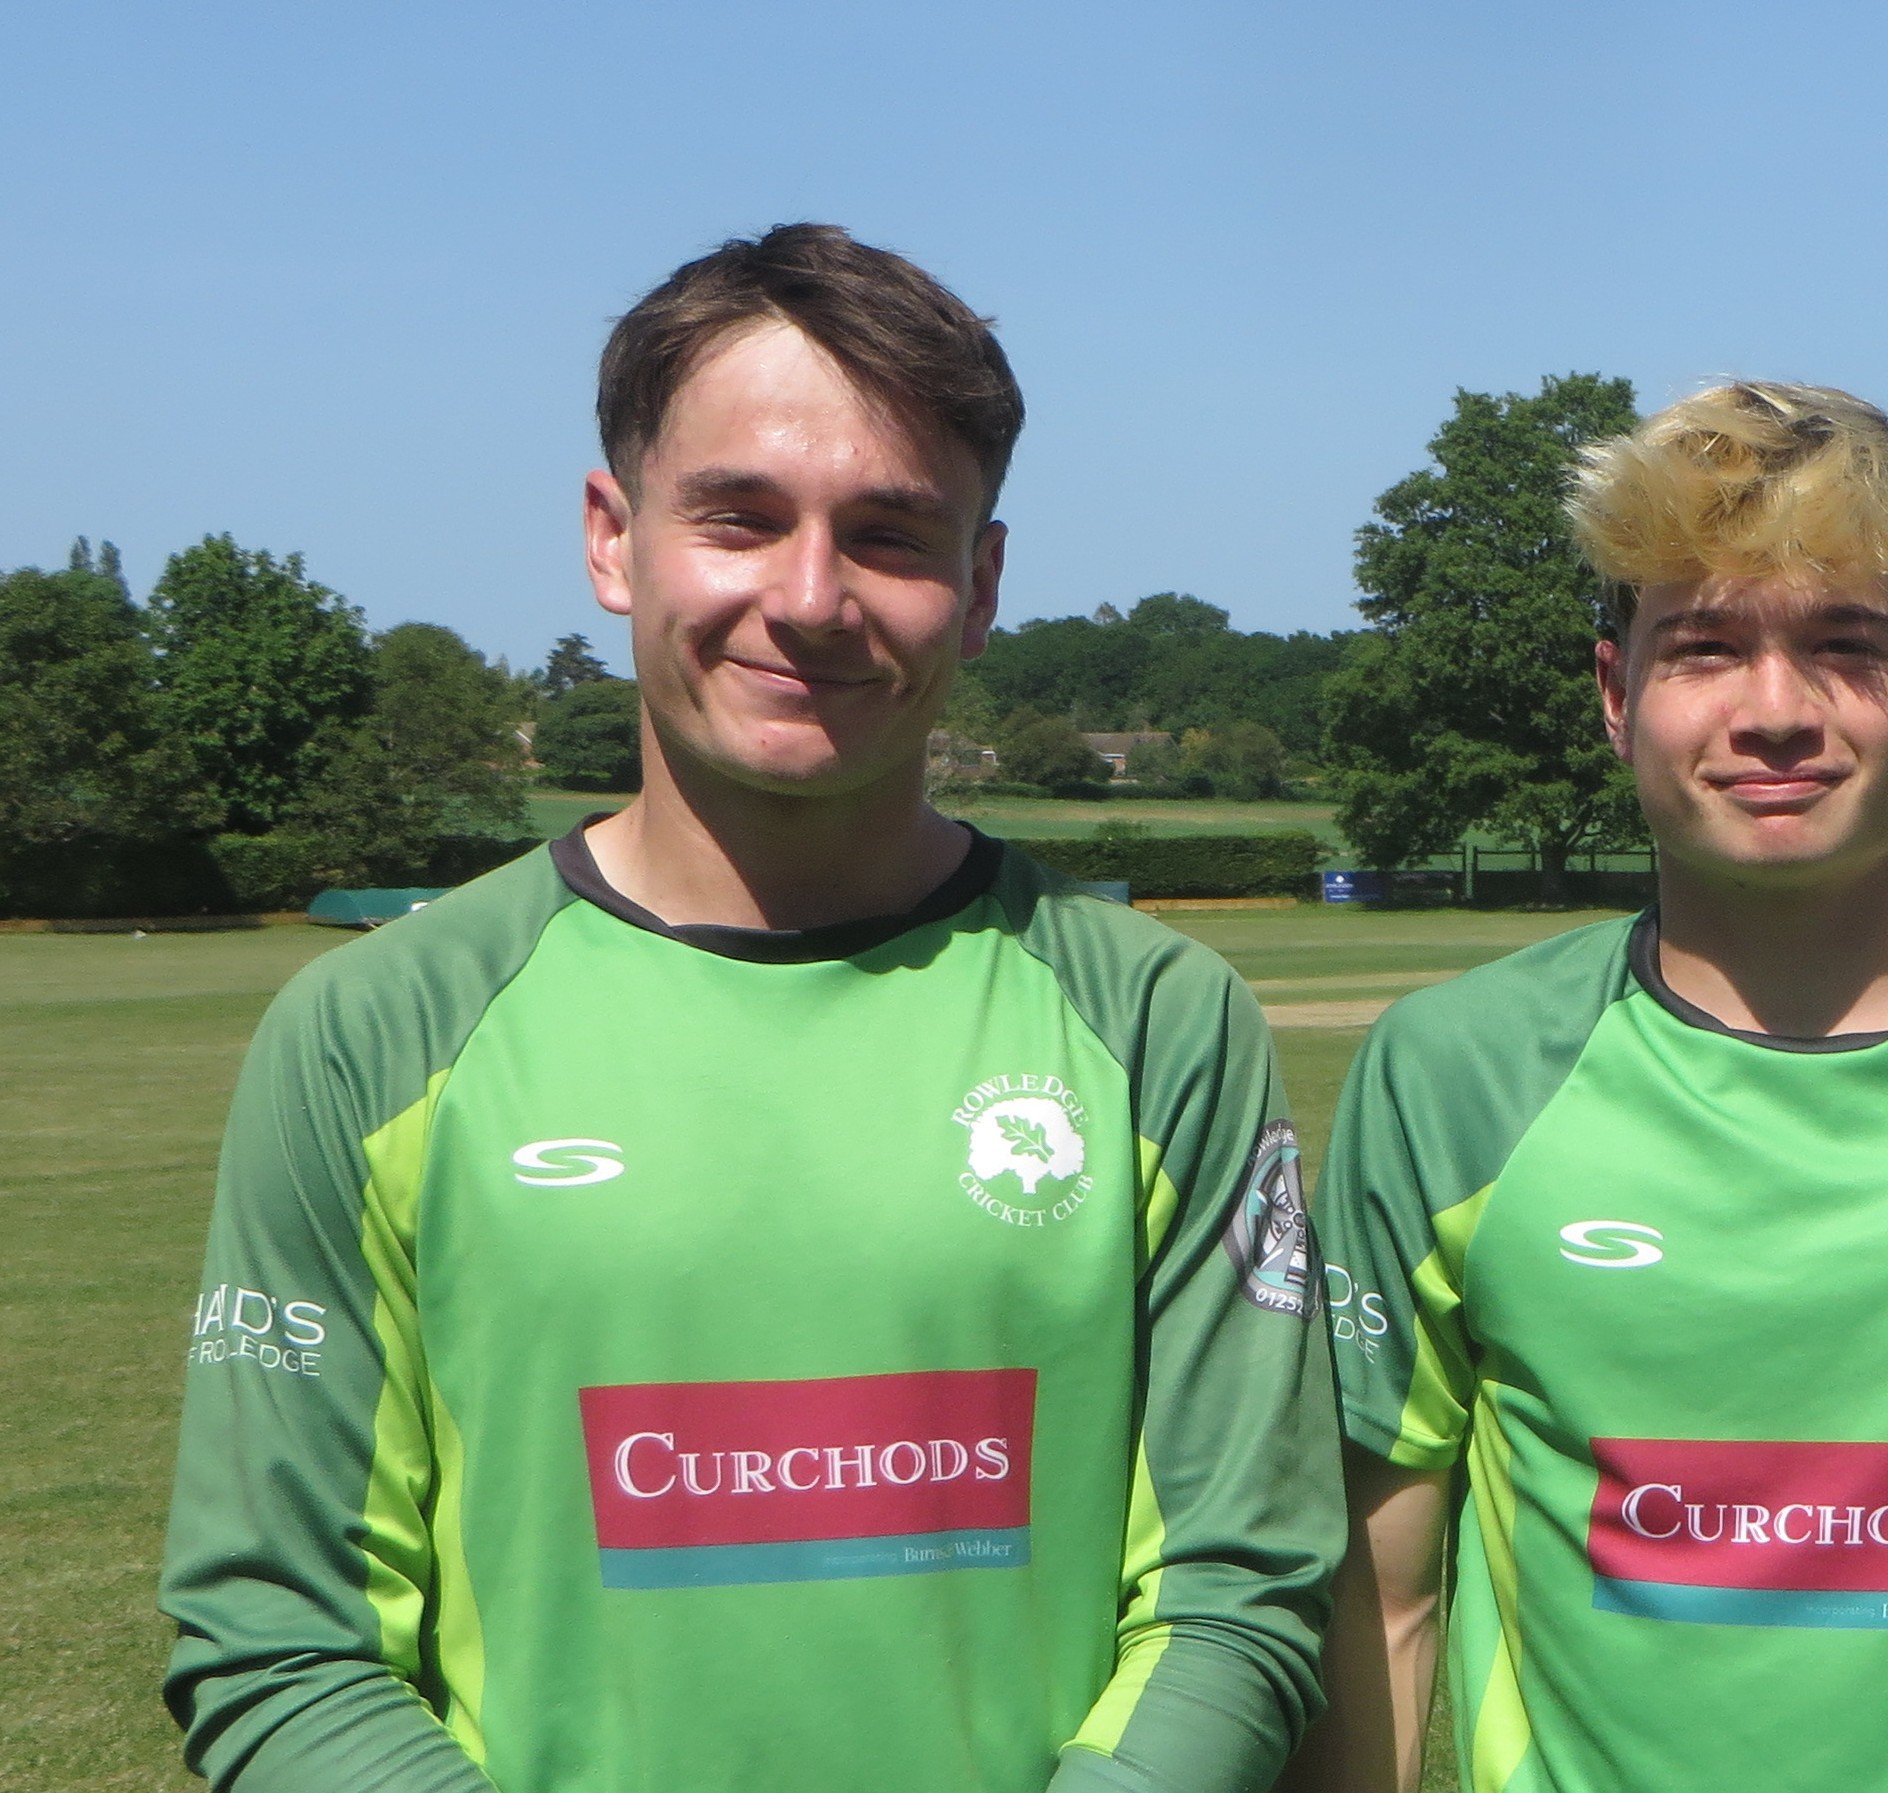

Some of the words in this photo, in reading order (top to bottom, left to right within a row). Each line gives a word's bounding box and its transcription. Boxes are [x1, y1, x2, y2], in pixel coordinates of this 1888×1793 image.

[951, 1073, 1089, 1128] ROWLEDGE
[958, 1172, 1047, 1227] CRICKET
[1052, 1174, 1094, 1221] CLUB
[613, 1431, 1011, 1499] CURCHODS
